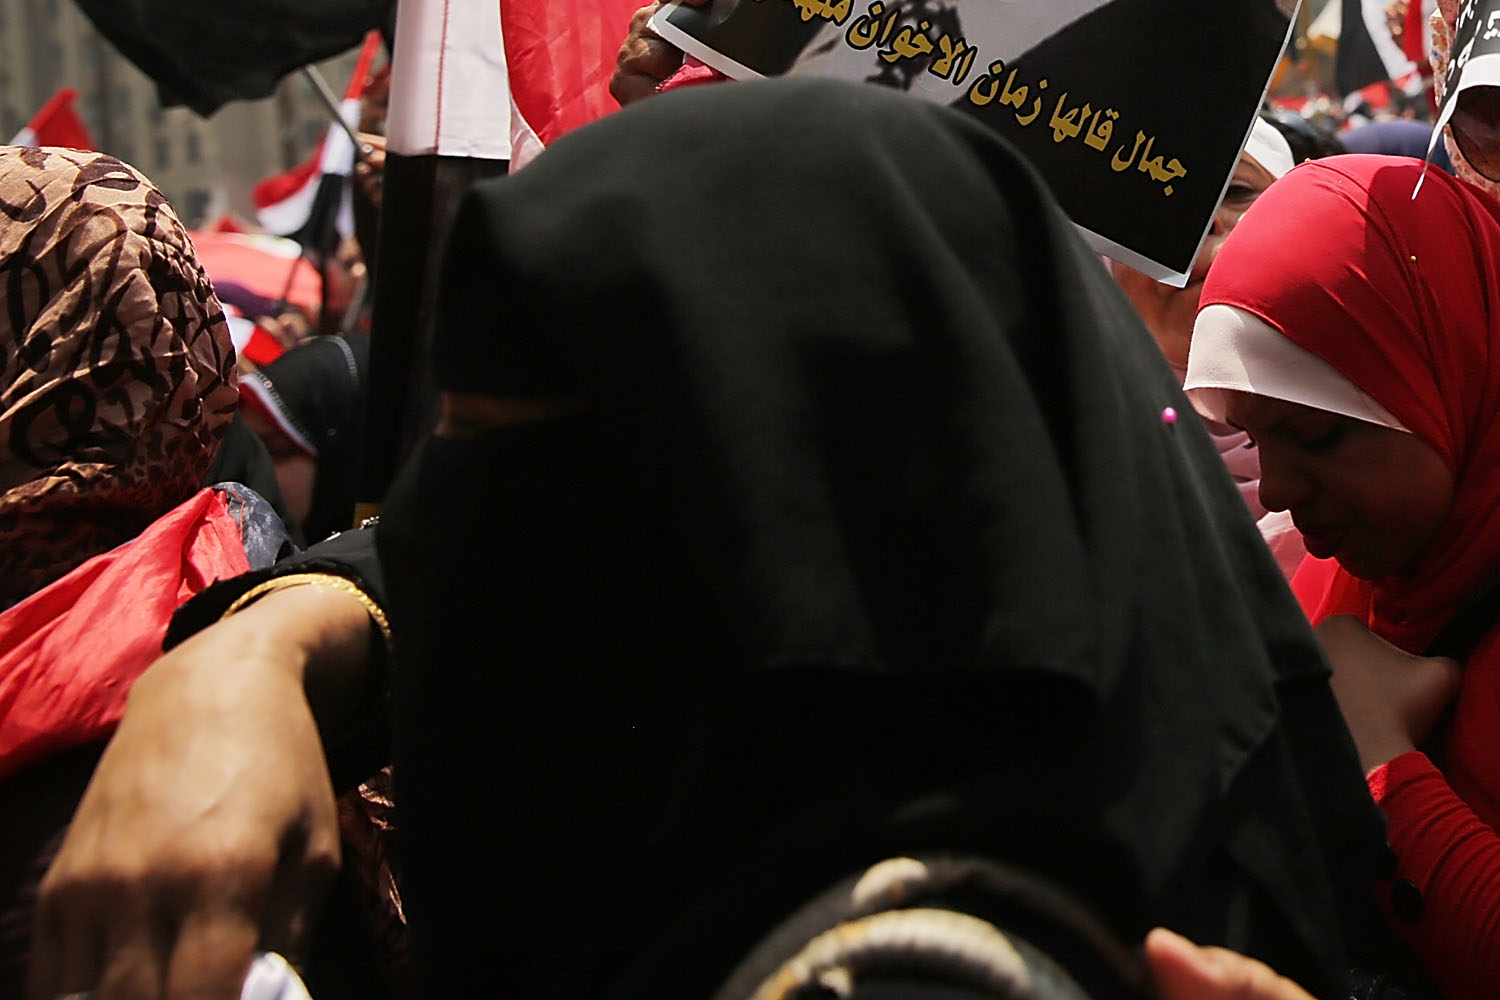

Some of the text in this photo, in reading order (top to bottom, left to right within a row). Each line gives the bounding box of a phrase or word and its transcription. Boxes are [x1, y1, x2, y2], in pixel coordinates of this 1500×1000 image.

[849, 3, 975, 83] الاخوان
[970, 63, 1048, 127] زمان
[1049, 92, 1120, 152] قالها
[1111, 130, 1188, 197] جمال
